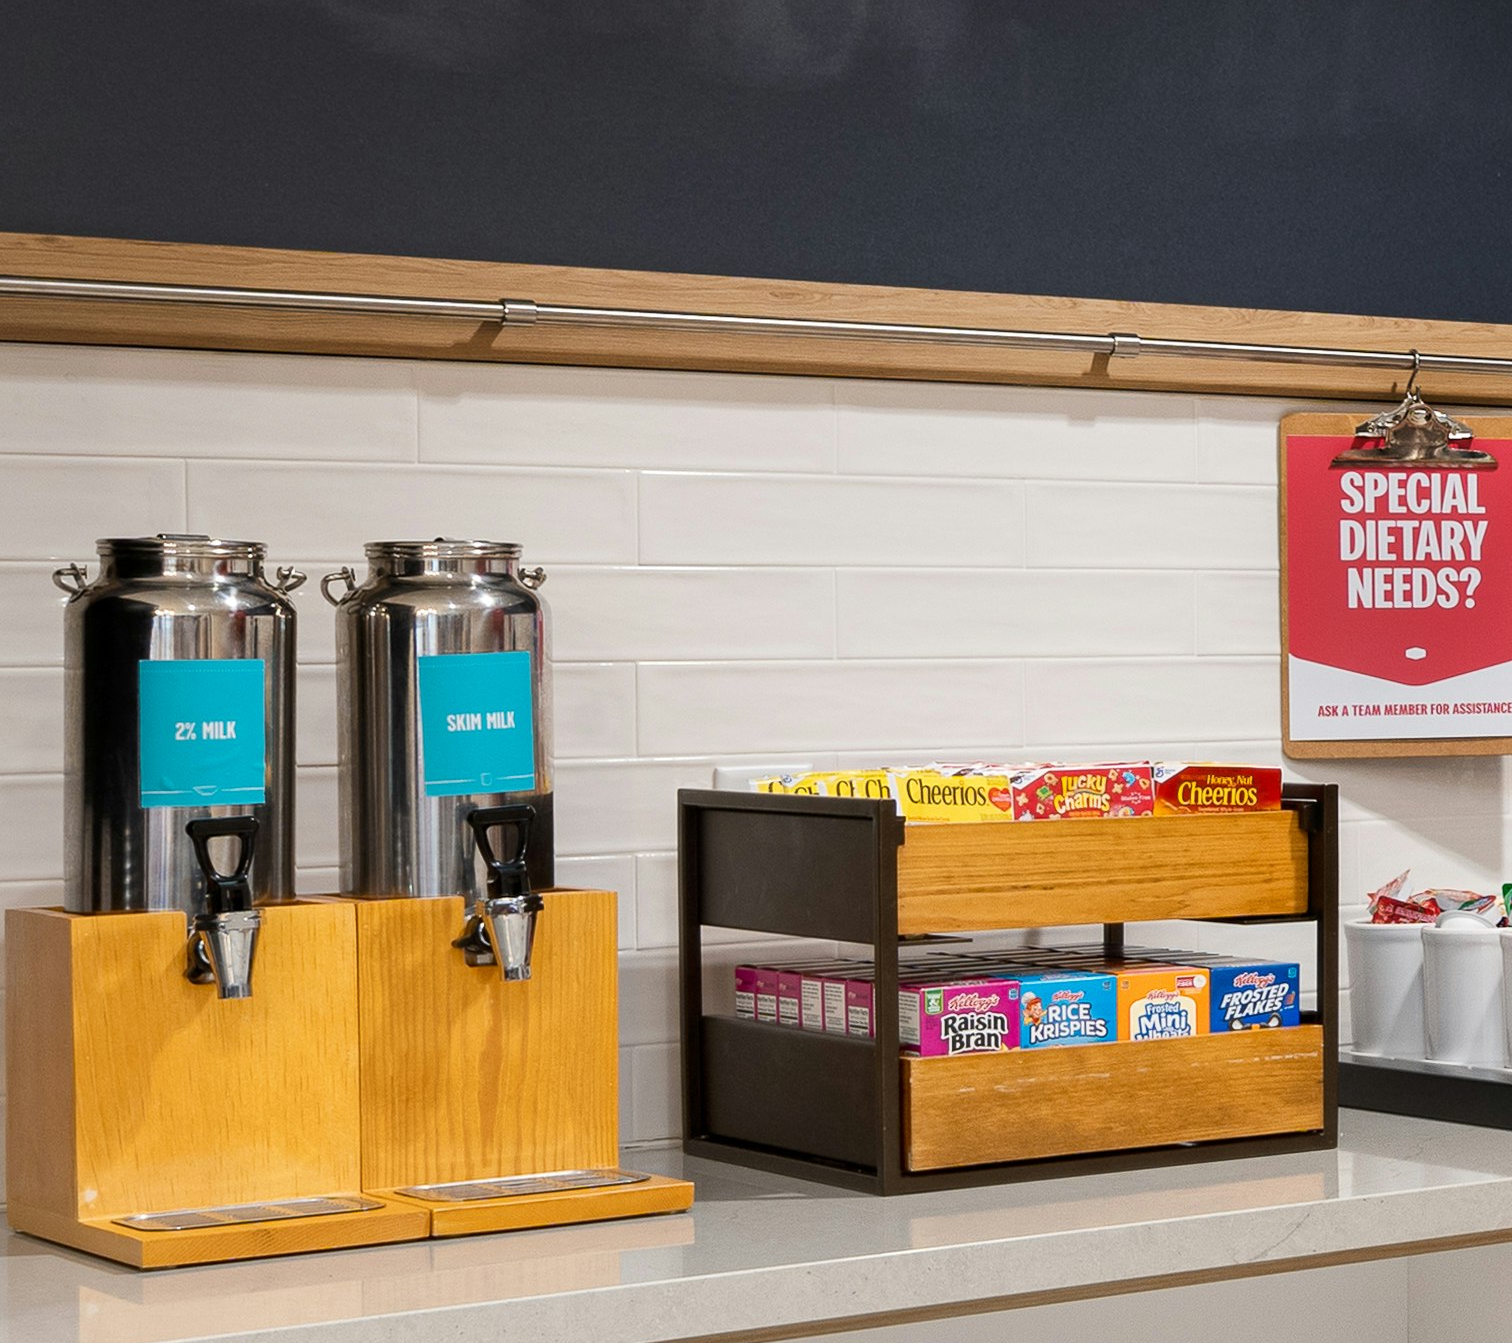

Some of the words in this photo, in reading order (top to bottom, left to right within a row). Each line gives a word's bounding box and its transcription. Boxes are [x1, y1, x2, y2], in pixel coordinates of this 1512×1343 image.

[1340, 471, 1486, 514] SPECIAL
[1339, 519, 1488, 561] DIETARY
[1347, 567, 1482, 609] NEEDS?
[1318, 705, 1339, 717] ASK
[1341, 705, 1349, 717] A
[1351, 704, 1381, 716] TEAM
[1384, 704, 1428, 716] MEMBER
[1430, 703, 1450, 715] FOR
[1452, 702, 1512, 715] ASSISTANCE
[174, 721, 197, 742] 2%
[201, 720, 237, 740] MILK
[446, 712, 482, 733] SKIM
[485, 710, 516, 731] MILK
[906, 777, 987, 807] Cheerios
[1061, 772, 1107, 797] Lucky
[1206, 774, 1235, 787] Honey
[1236, 775, 1253, 786] Nut
[1054, 791, 1111, 814] Charms
[1177, 780, 1258, 806] Cheerios
[948, 993, 1000, 1013] Kellogg's
[1221, 982, 1290, 1008] FROSTED
[1047, 1003, 1091, 1022] RICE
[1146, 1002, 1181, 1014] Frosted
[1225, 998, 1283, 1021] FLAKES
[943, 1013, 1007, 1038] Raisin
[1030, 1019, 1108, 1044] KRISPIES
[1140, 1011, 1188, 1035] Mini
[951, 1031, 1000, 1053] Bran
